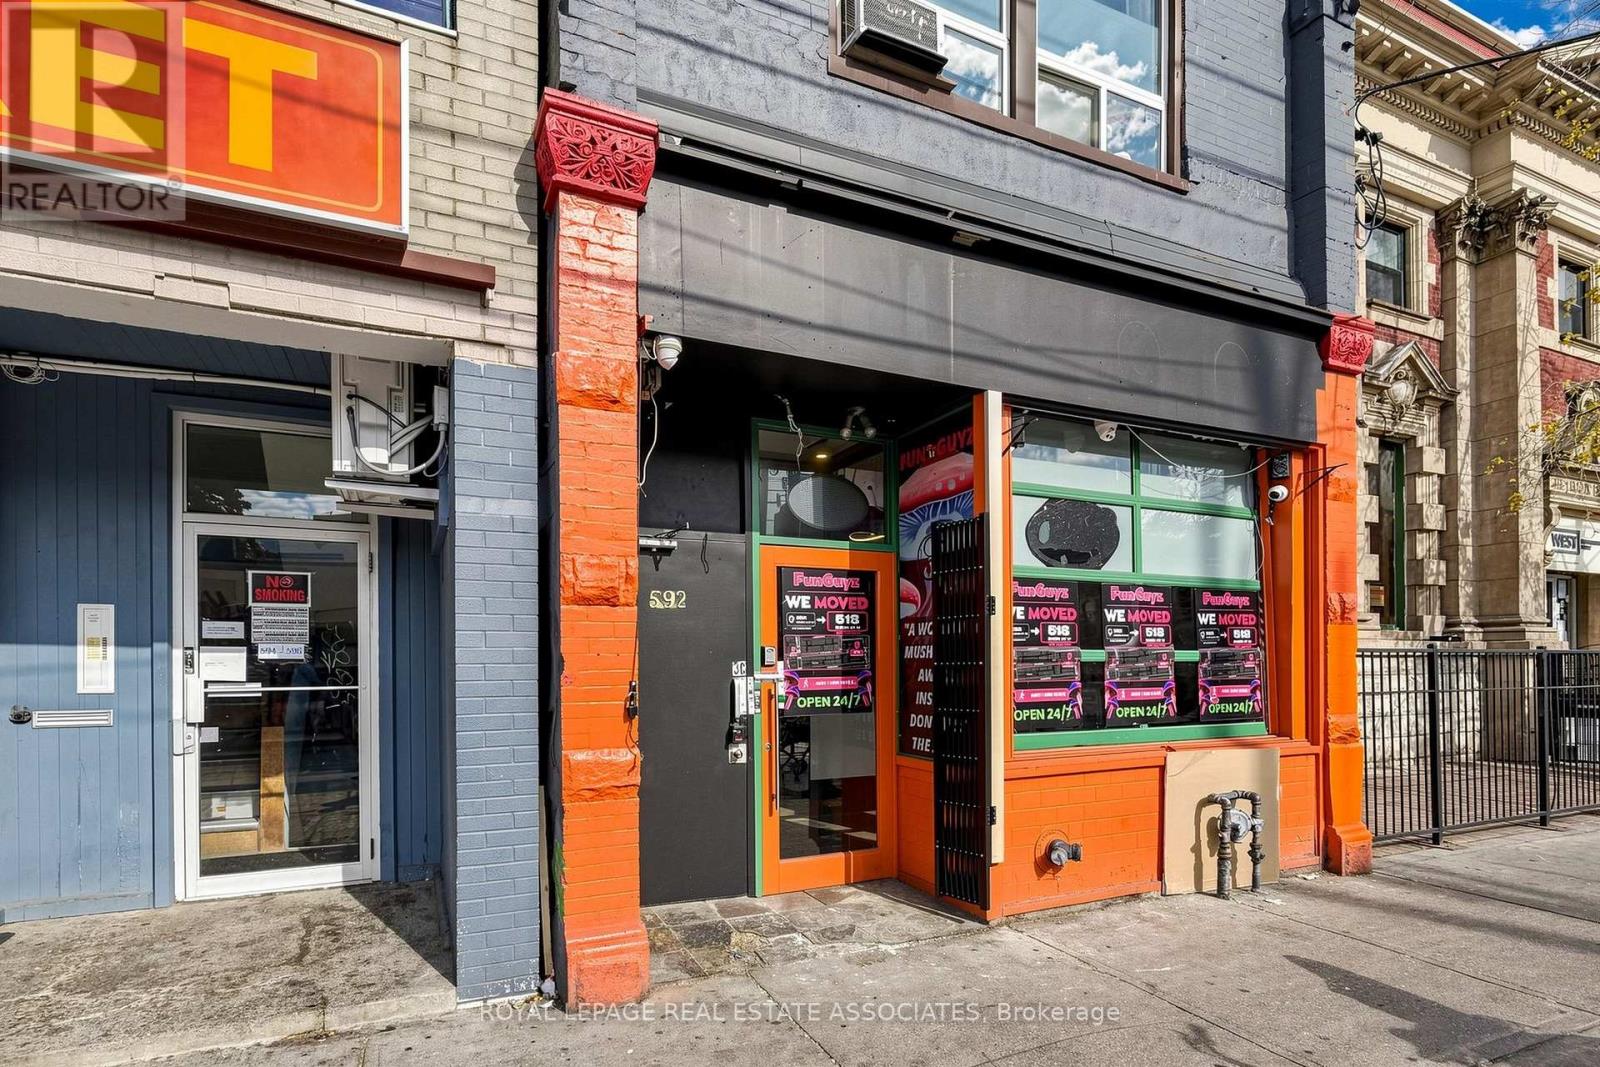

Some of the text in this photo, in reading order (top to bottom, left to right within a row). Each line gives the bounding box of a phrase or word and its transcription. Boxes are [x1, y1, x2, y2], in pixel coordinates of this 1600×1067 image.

[0, 0, 318, 172] ET
[1551, 533, 1577, 550] WEST
[265, 575, 294, 588] NO
[792, 571, 860, 591] FunGuyz
[255, 588, 305, 602] SMOKING
[649, 590, 686, 609] 592
[785, 594, 869, 610] WE MOVED
[1110, 585, 1164, 605] FunGuyz
[1202, 591, 1250, 609] FunGuyz
[834, 613, 860, 625] 518
[1012, 605, 1078, 621] E MOVED
[1104, 608, 1171, 623] WE MOVED
[1197, 613, 1257, 626] WE MOVED
[1047, 624, 1071, 636] 518
[1145, 627, 1165, 637] 518
[796, 692, 861, 709] OPEN 24/7
[1208, 699, 1253, 715] OPEN 24/7
[1014, 704, 1073, 722] OPEN 24/7
[1116, 702, 1168, 719] OPEN 24/7
